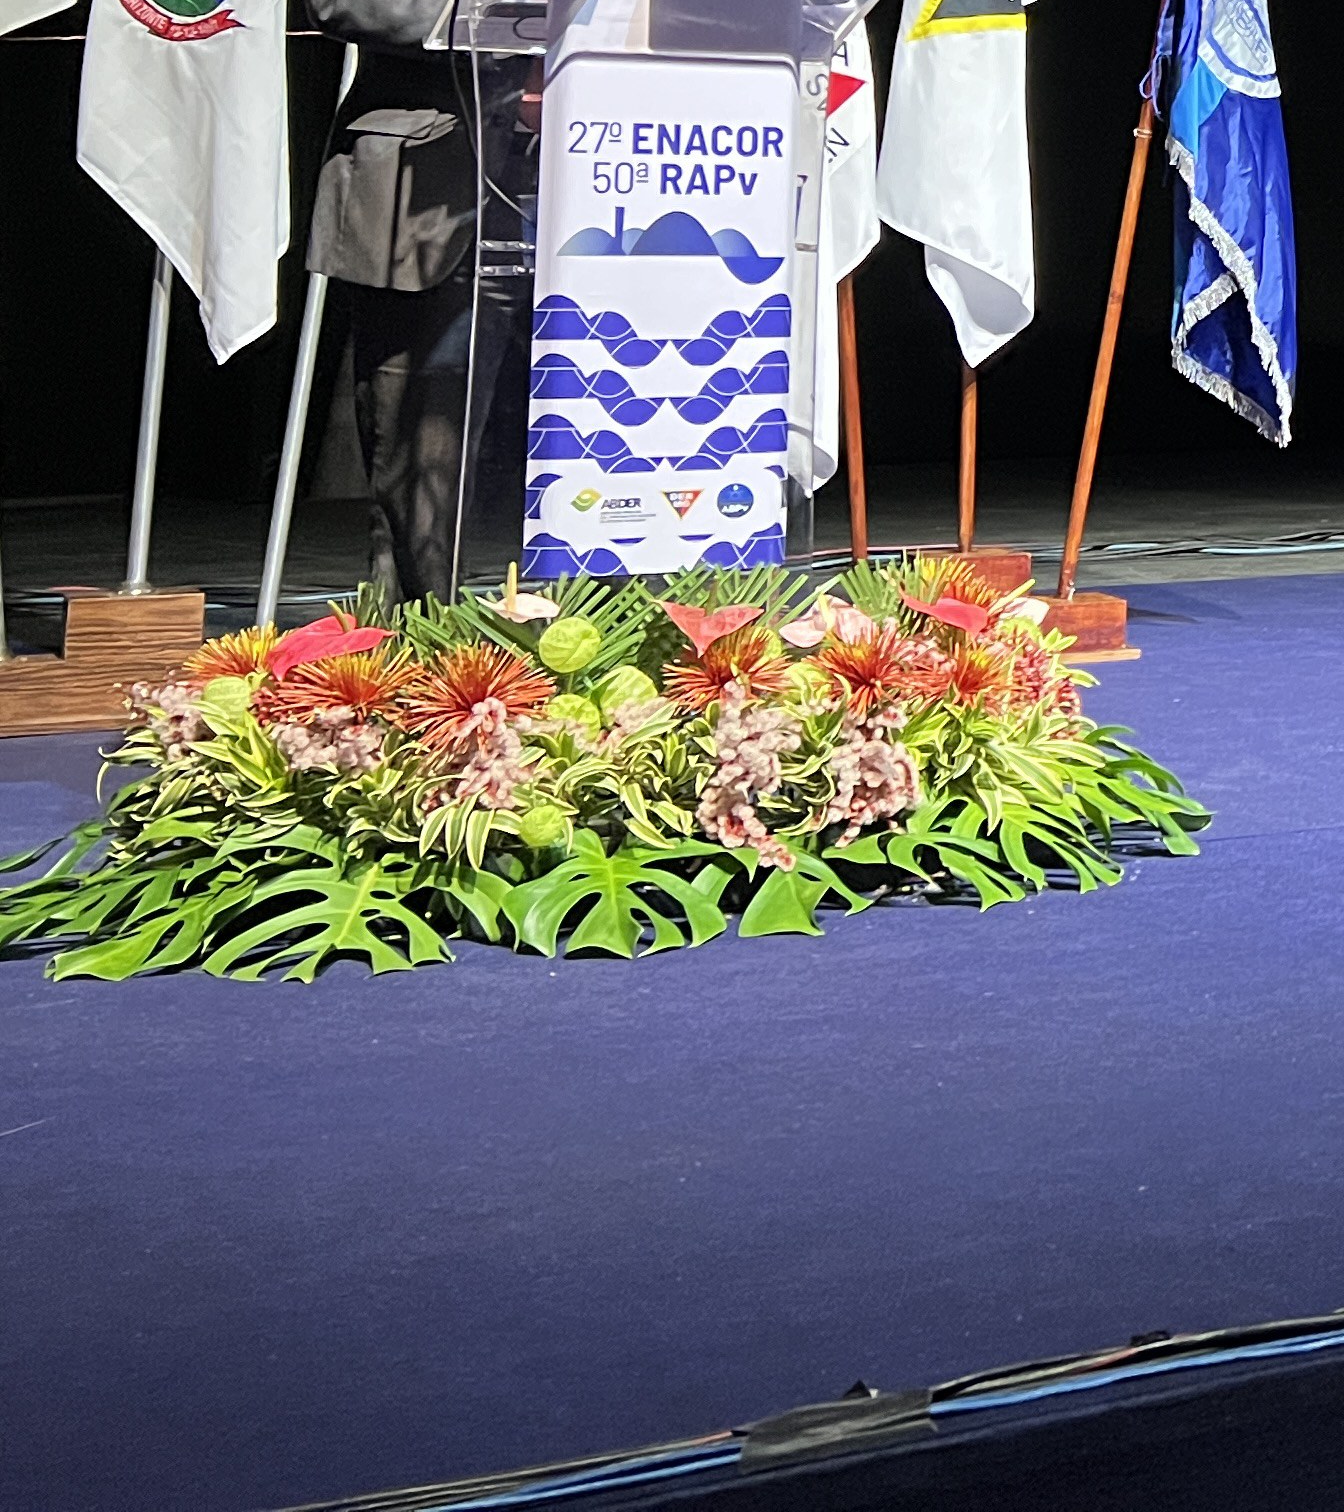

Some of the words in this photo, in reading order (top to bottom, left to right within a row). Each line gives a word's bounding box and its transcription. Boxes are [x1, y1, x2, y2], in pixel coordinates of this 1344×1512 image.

[568, 121, 622, 154] 27º
[632, 123, 784, 157] ENACOR
[593, 161, 649, 194] 50ª
[660, 163, 758, 195] RAPv
